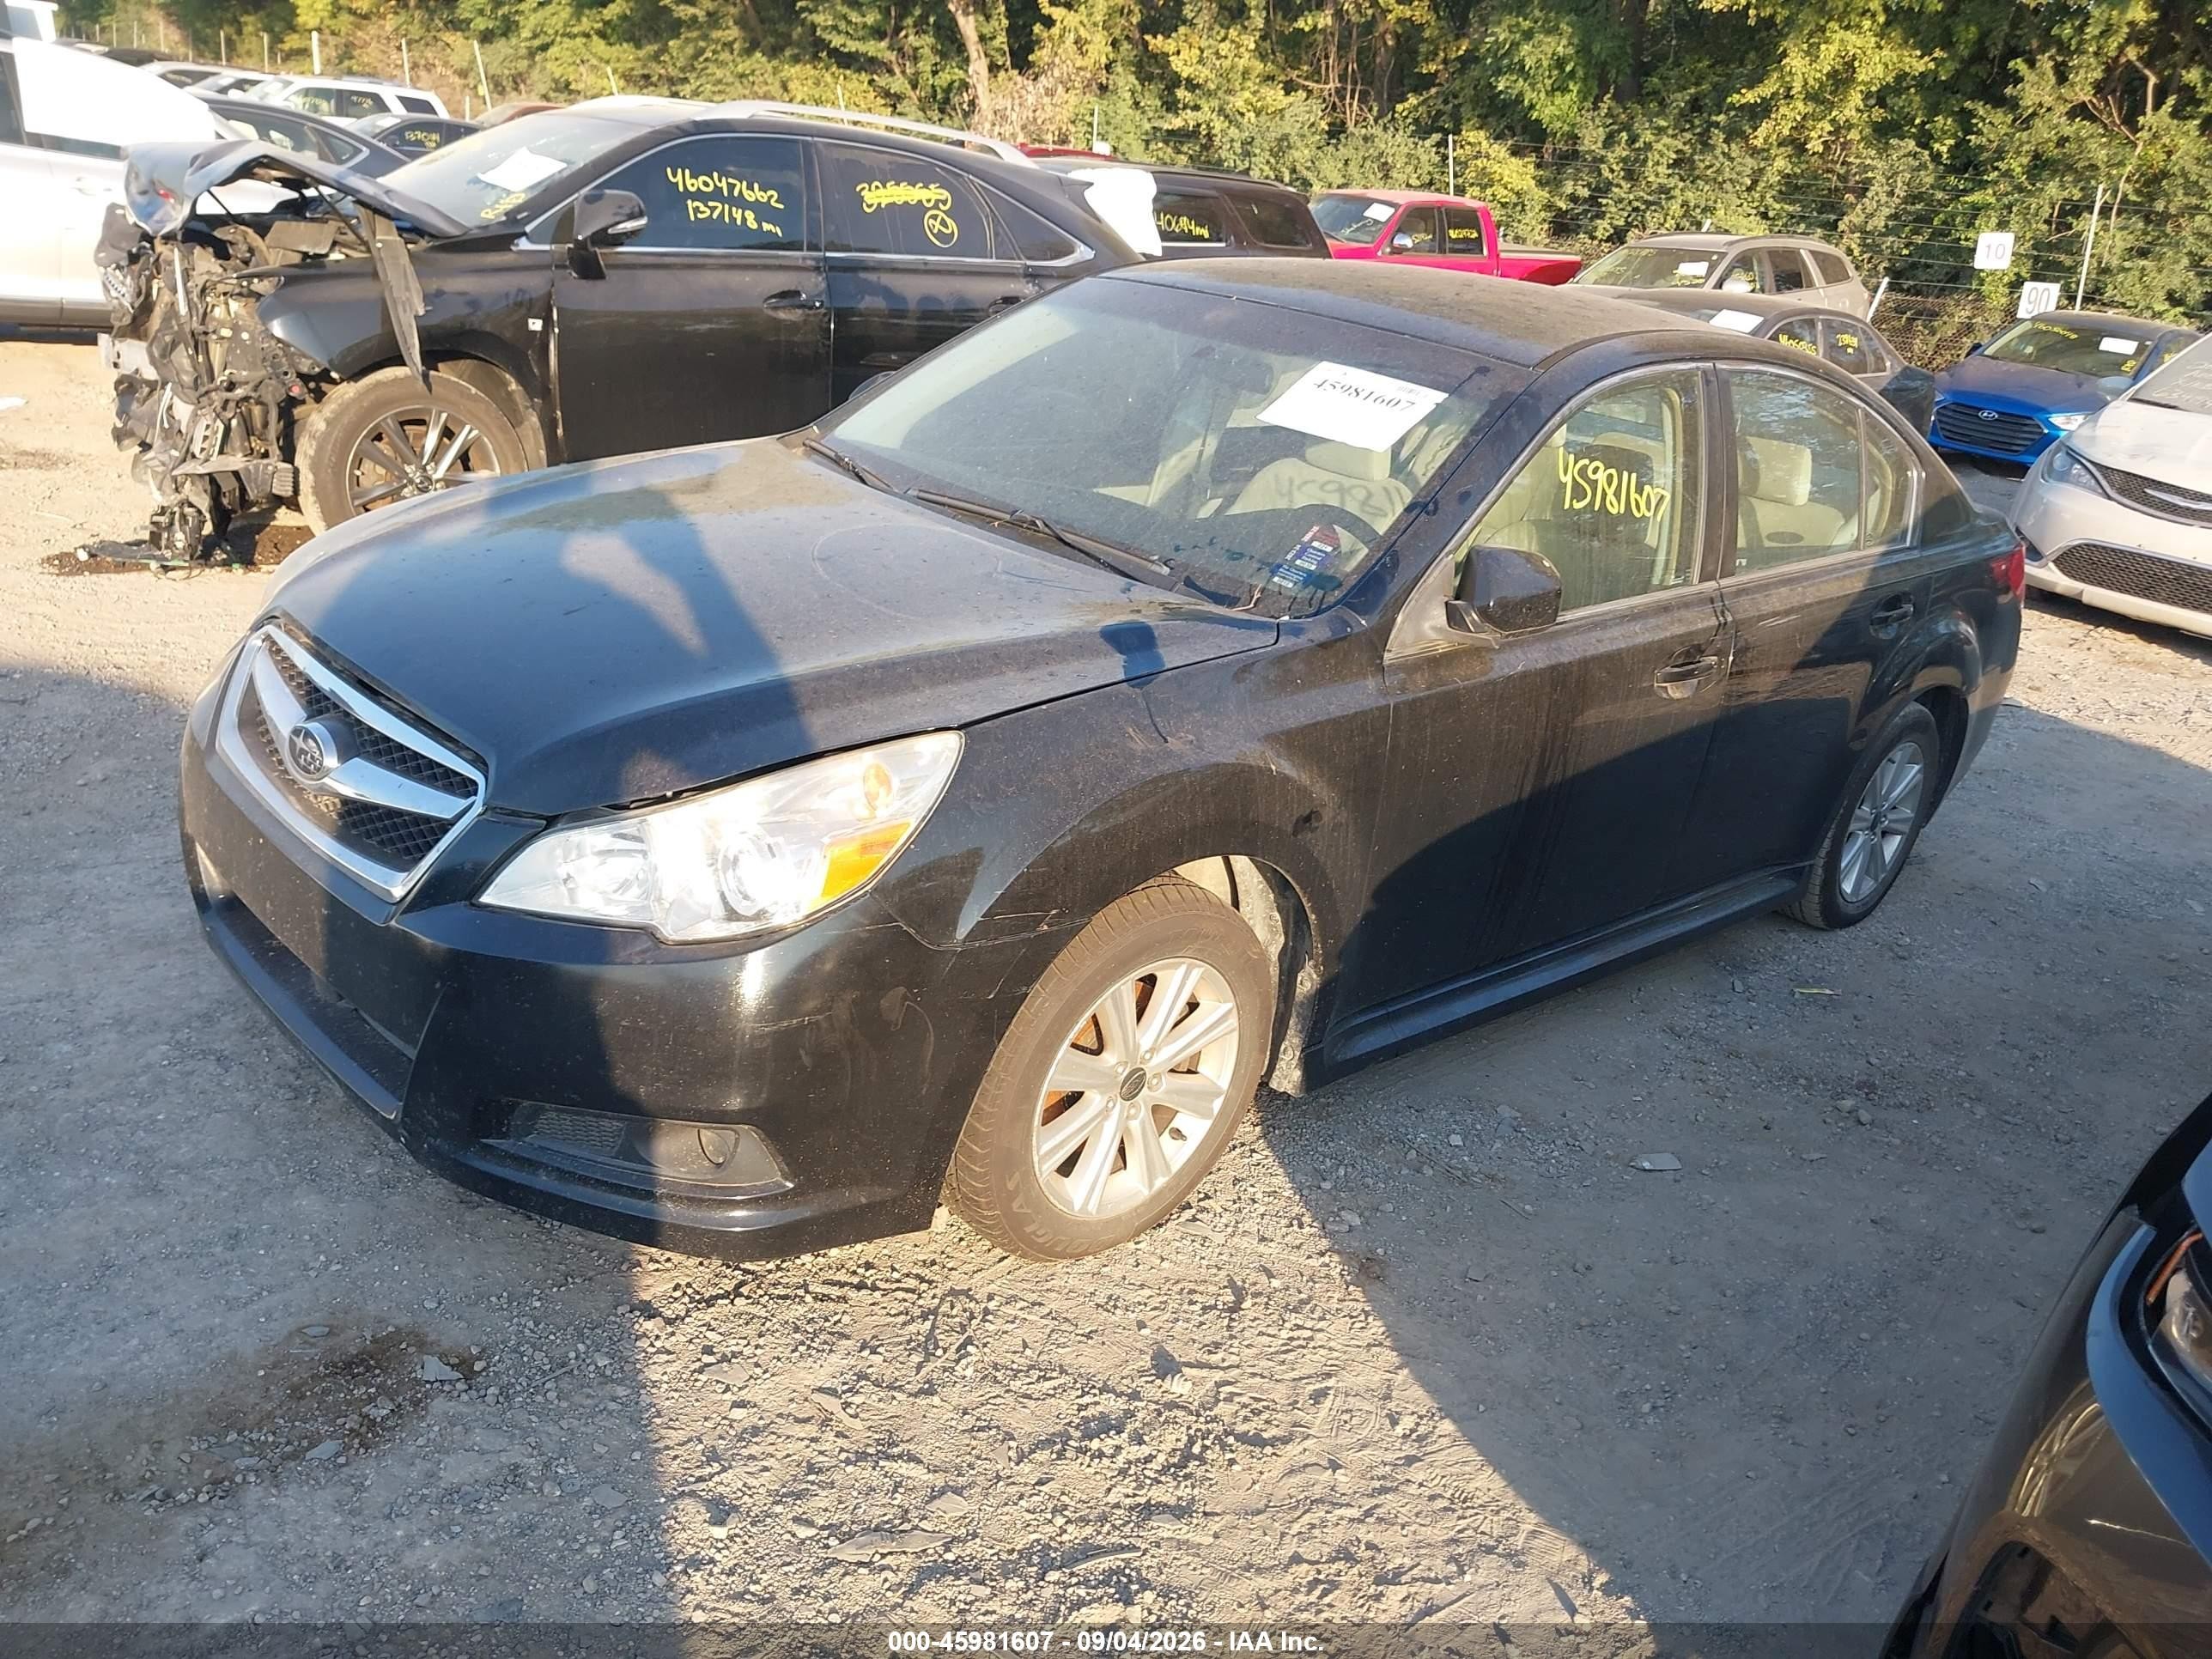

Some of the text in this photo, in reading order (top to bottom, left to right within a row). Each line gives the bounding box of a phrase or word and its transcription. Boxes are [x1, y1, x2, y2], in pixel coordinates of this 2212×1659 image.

[666, 167, 785, 210] 46047662
[686, 199, 758, 230] 137148
[1985, 243, 2006, 260] 10
[2027, 287, 2051, 314] 90
[1313, 378, 1416, 411] 45981607
[1559, 447, 1671, 522] 45981607
